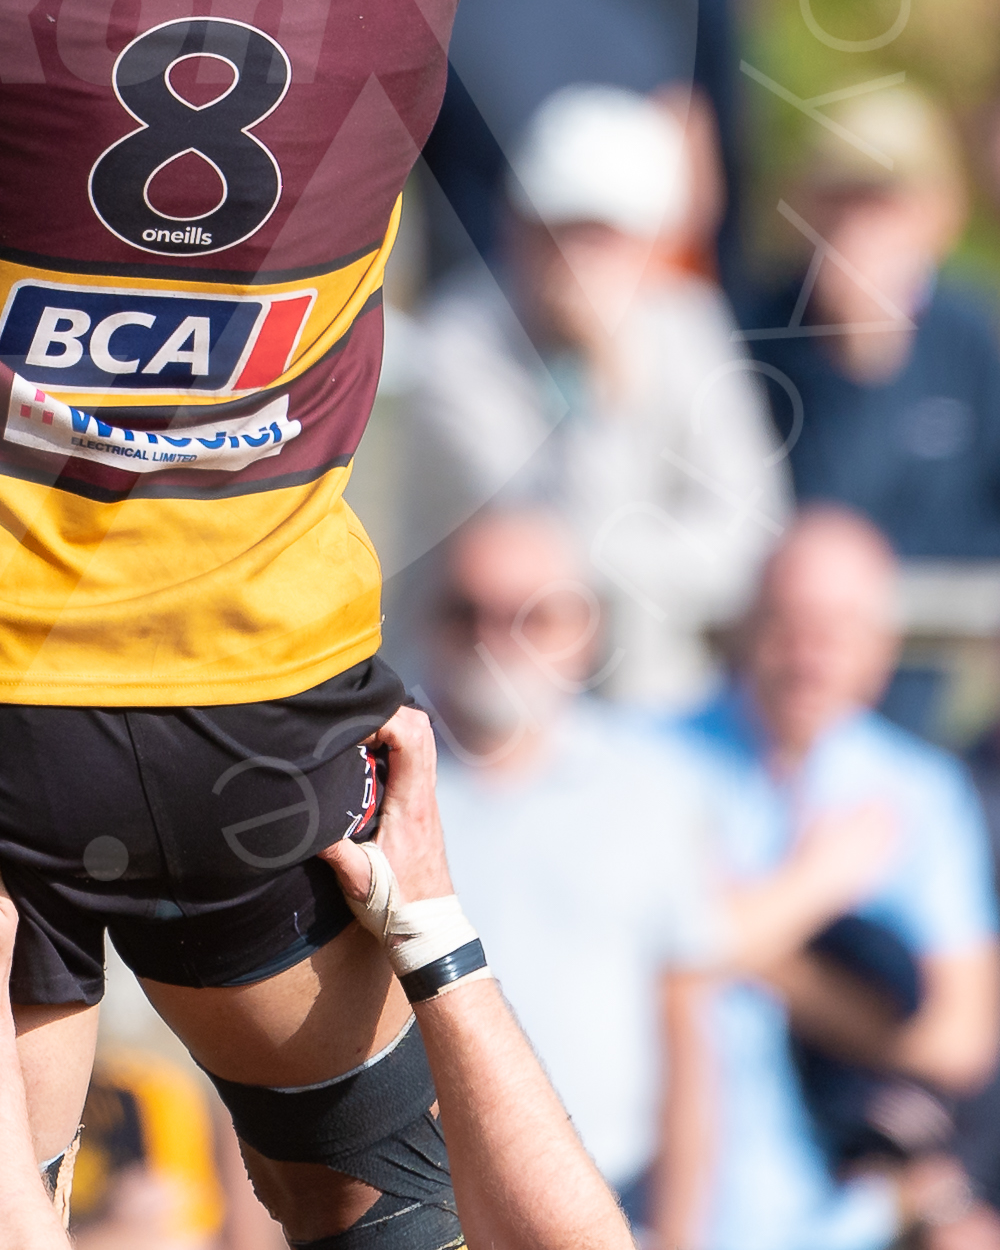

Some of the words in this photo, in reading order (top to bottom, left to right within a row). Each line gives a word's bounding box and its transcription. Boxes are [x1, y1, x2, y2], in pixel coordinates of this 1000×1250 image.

[88, 16, 292, 257] 8
[25, 306, 211, 376] BCA
[71, 436, 149, 461] ELECTRICAL
[152, 451, 198, 464] LIMITED
